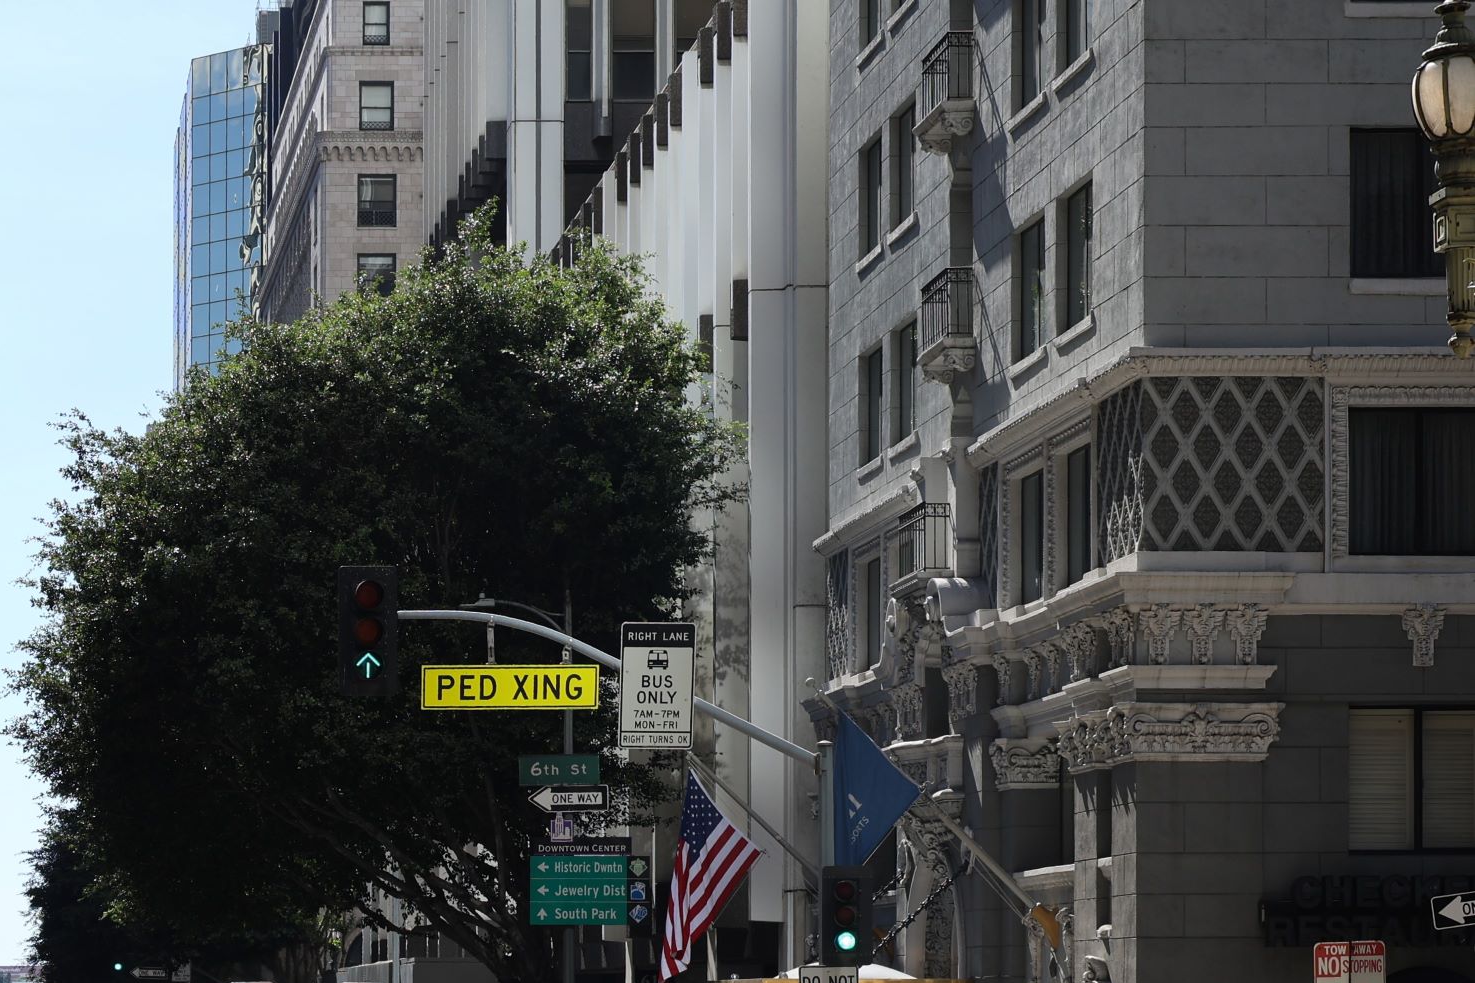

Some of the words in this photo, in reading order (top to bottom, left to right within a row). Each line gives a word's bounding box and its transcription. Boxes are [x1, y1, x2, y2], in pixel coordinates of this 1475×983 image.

[628, 632, 657, 641] RIGHT
[663, 632, 689, 641] LANE
[438, 675, 497, 700] PED
[512, 673, 583, 700] XING
[642, 675, 673, 688] BUS
[637, 691, 677, 704] ONLY
[623, 736, 645, 744] RIGHT
[649, 736, 673, 744] TURNS
[677, 736, 688, 744] OK
[531, 762, 559, 776] 6th
[571, 763, 587, 775] St
[552, 794, 573, 804] ONE
[578, 793, 599, 803] WAY
[555, 862, 591, 873] Historic
[594, 862, 623, 873] Dwntn
[555, 885, 599, 899] Jewelry
[603, 885, 626, 896] Dist
[1290, 874, 1475, 909] CHECKE
[555, 908, 587, 920] South
[592, 908, 617, 920] Park
[1325, 946, 1347, 956] TOW
[1353, 945, 1377, 955] AWAY
[1318, 957, 1340, 975] NO
[1343, 959, 1382, 974] STOPPING
